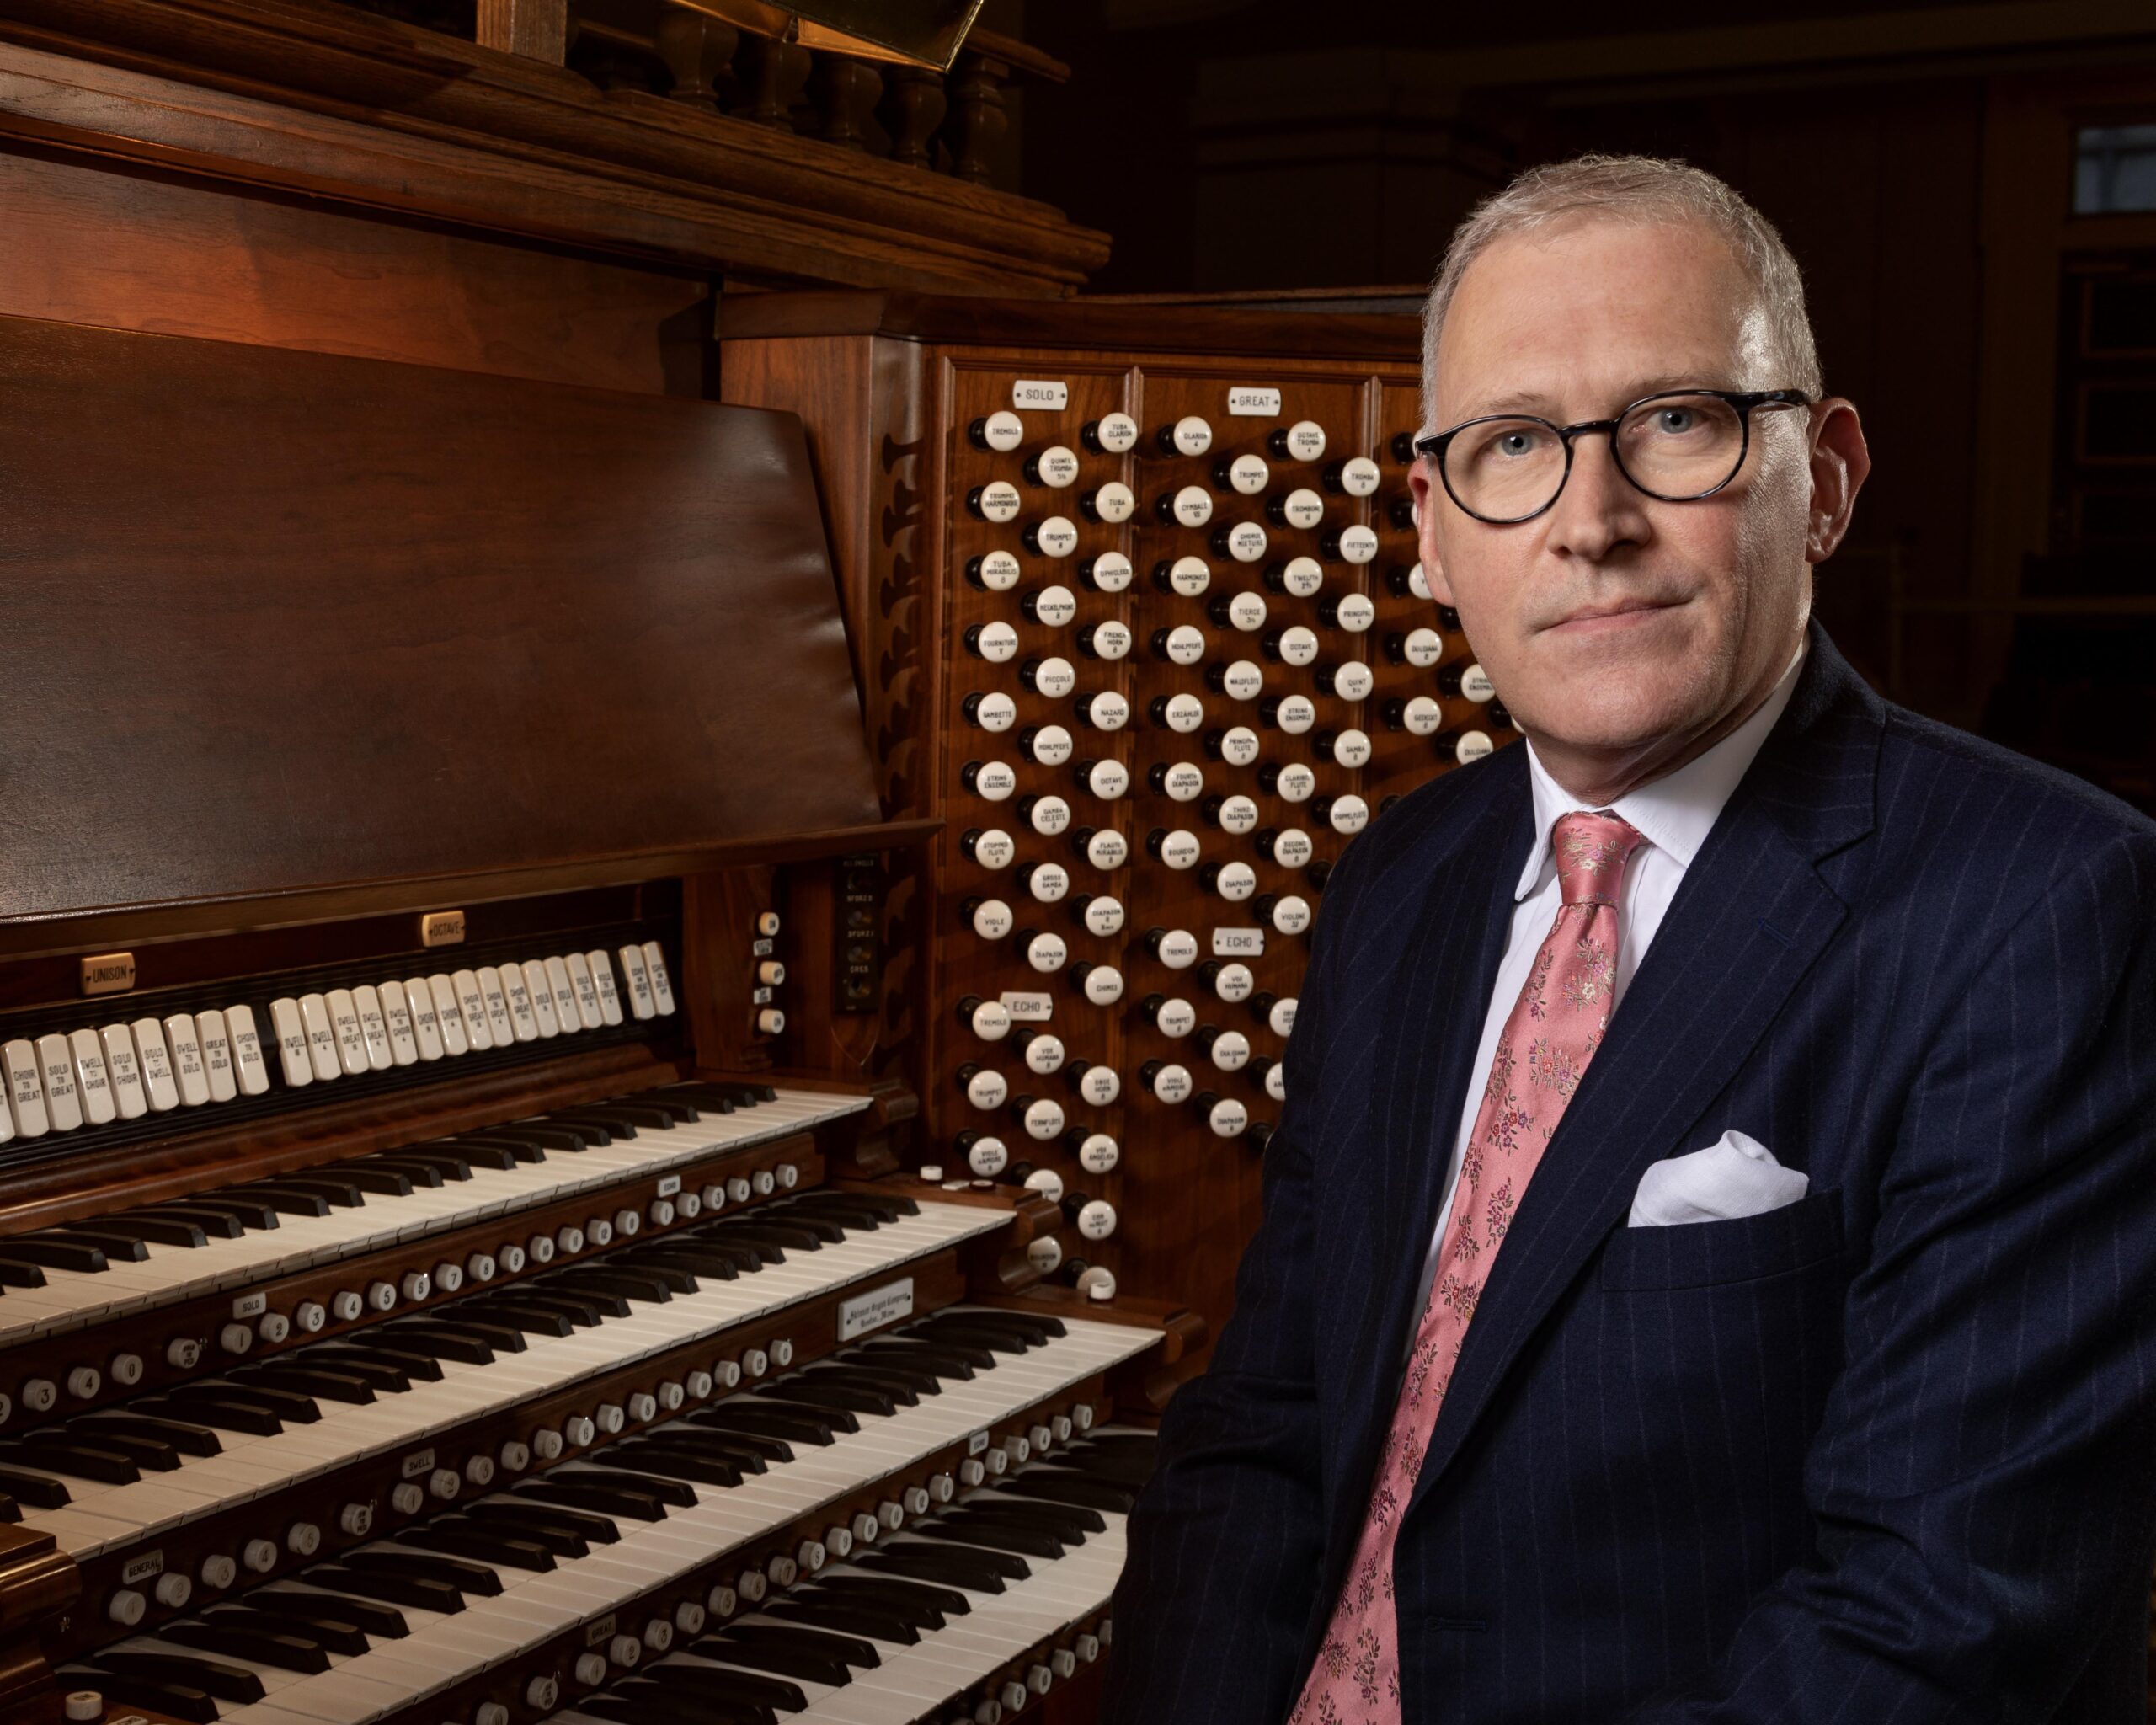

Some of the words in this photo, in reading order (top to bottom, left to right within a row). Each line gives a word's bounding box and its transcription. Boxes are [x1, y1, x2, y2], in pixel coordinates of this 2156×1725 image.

[1025, 388, 1054, 402] SOLO
[1239, 395, 1271, 407] GREAT
[1347, 678, 1367, 686] QUINT
[1100, 777, 1123, 785] OCTAVE
[1167, 847, 1196, 856] BOURDON
[434, 921, 460, 937] OCTAVE
[1226, 936, 1253, 948] ECHO
[93, 964, 127, 983] UNISON
[1012, 1000, 1041, 1012] ECHO
[337, 1015, 358, 1026] SWELL
[237, 1033, 255, 1045] CHOIR
[285, 1036, 307, 1049] SWELL
[312, 1031, 334, 1044] SWELL
[343, 1033, 362, 1044] GREAT
[177, 1044, 198, 1056] SWELL
[206, 1039, 225, 1049] GREAT
[113, 1053, 131, 1065] SOLO
[144, 1047, 163, 1060] SOLO
[242, 1052, 259, 1063] SOLO
[48, 1064, 68, 1076] SOLO
[80, 1059, 103, 1069] SWELL
[183, 1062, 200, 1074] SOLO
[211, 1058, 228, 1070] SOLO
[13, 1069, 36, 1081] CHOIR
[117, 1073, 138, 1085] CHOIR
[149, 1068, 171, 1079] SWELL
[51, 1083, 73, 1097] GREAT
[85, 1078, 107, 1090] CHOIR
[18, 1090, 40, 1103] GREAT
[664, 1182, 676, 1191] ECHO
[764, 1178, 771, 1189] 5
[739, 1186, 746, 1195] 4
[714, 1193, 722, 1204] 3
[664, 1209, 669, 1220] 1
[600, 1228, 608, 1239] 12
[572, 1236, 579, 1247] 11
[542, 1245, 550, 1257] 10
[513, 1253, 520, 1266] 9
[483, 1263, 489, 1275] 8
[451, 1273, 458, 1285] 7
[418, 1281, 424, 1294] 6
[383, 1290, 391, 1305] 5
[243, 1300, 259, 1312] SOLO
[350, 1300, 356, 1312] 4
[312, 1312, 320, 1326] 3
[275, 1322, 283, 1336] 2
[239, 1333, 244, 1348] 1
[84, 1376, 93, 1389] 4
[700, 1380, 708, 1391] 10
[40, 1389, 50, 1404] 3
[673, 1391, 680, 1403] 9
[644, 1402, 651, 1417] 8
[613, 1413, 621, 1427] 7
[583, 1427, 590, 1440] 6
[974, 1439, 987, 1451] ECHO
[409, 1457, 432, 1473] SWELL
[261, 1549, 270, 1562] 4
[128, 1559, 162, 1578] GENERAL
[784, 1566, 792, 1579] 7
[755, 1581, 761, 1594] 6
[592, 1623, 614, 1641] GREAT
